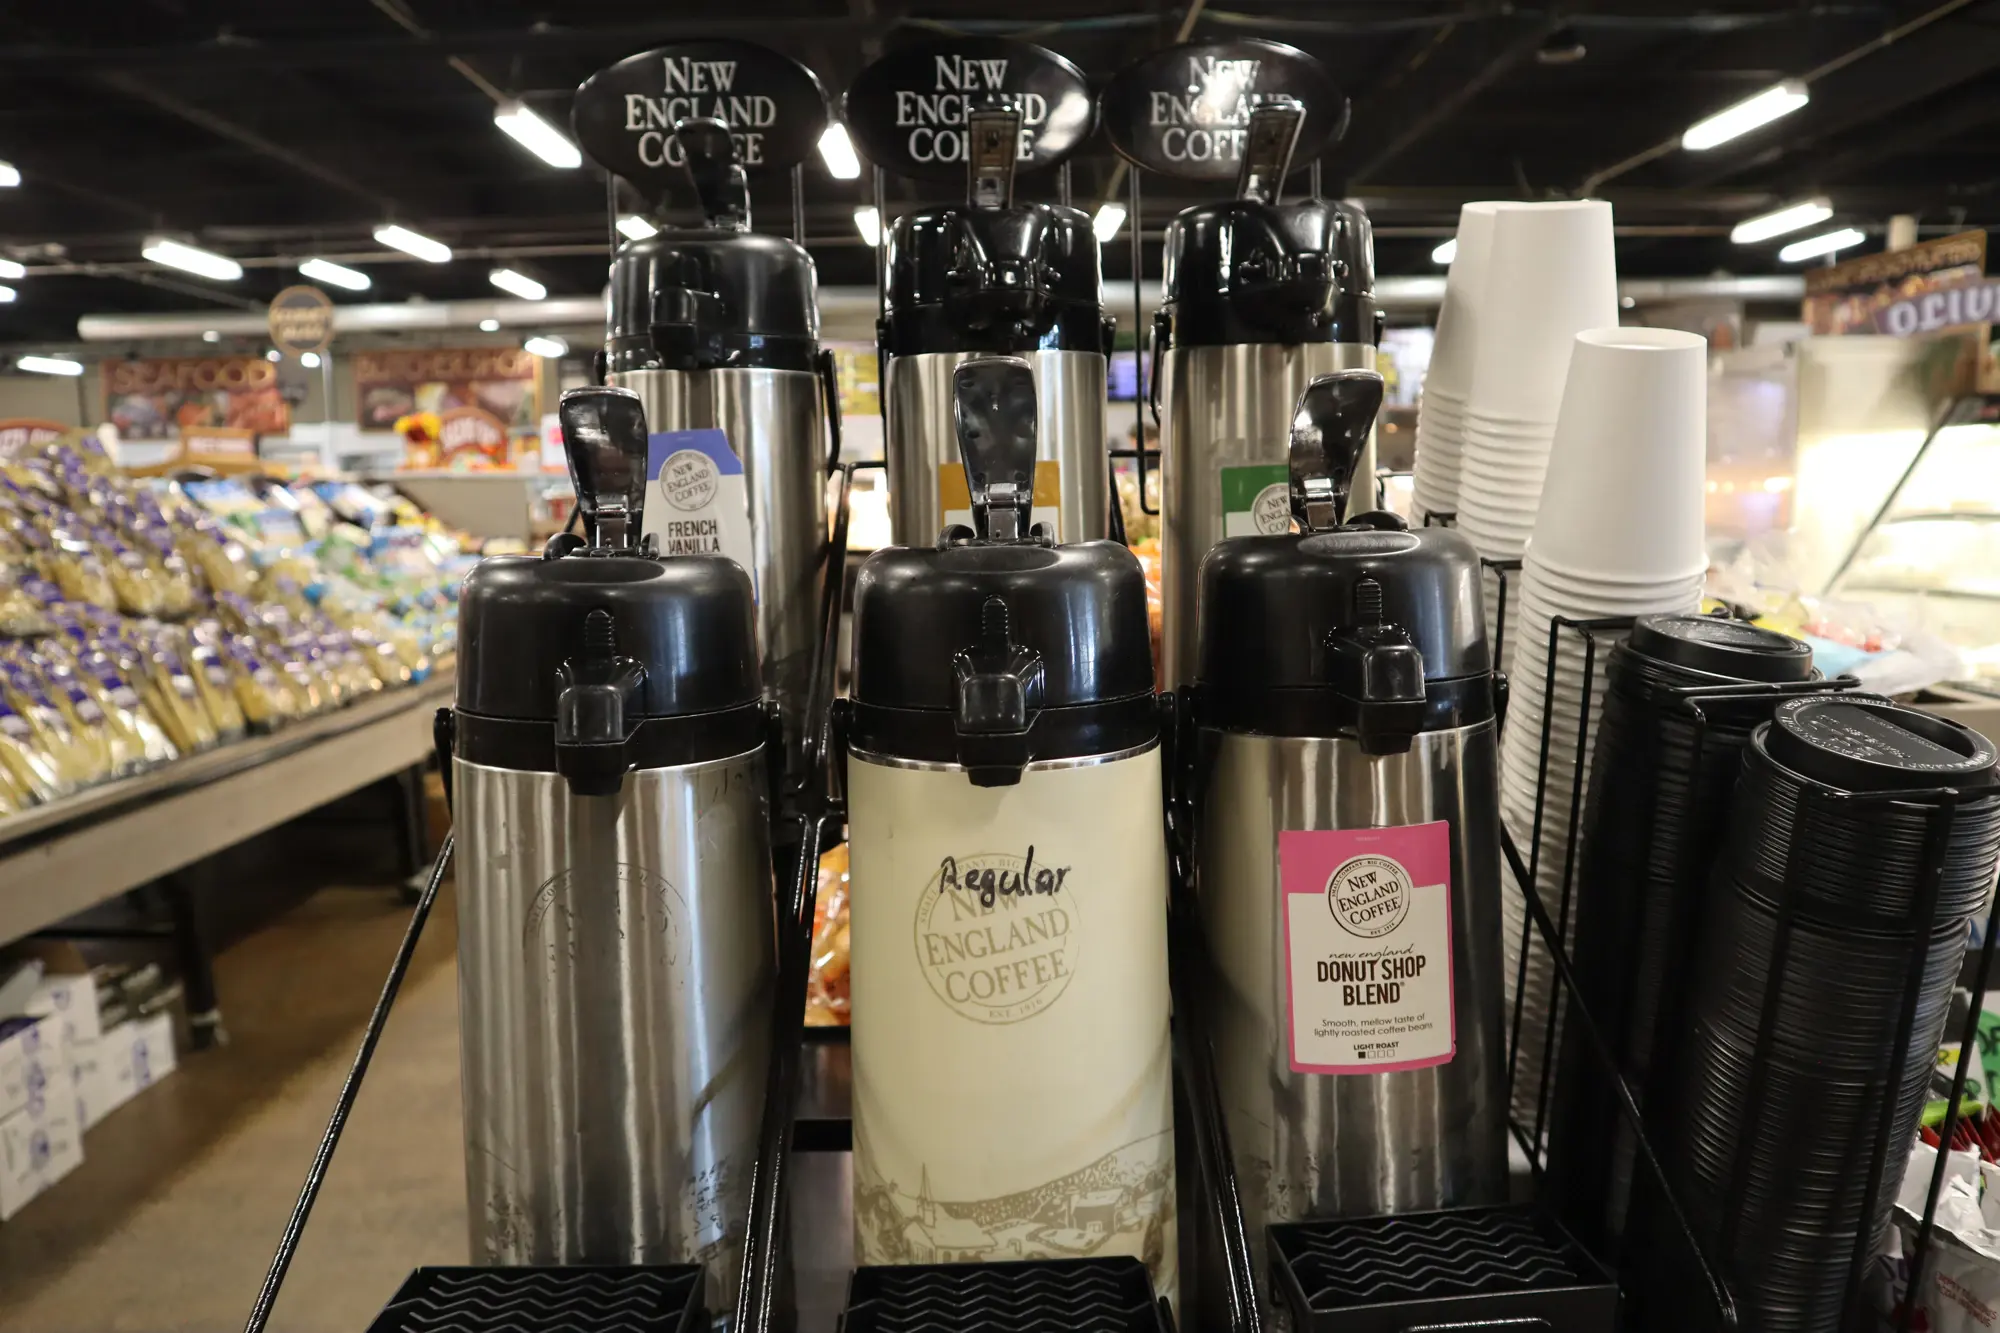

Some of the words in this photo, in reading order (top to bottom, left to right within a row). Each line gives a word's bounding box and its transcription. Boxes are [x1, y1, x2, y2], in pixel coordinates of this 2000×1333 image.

[663, 56, 738, 94] NEW
[934, 54, 1009, 91] NEW
[895, 90, 1047, 126] ENGLD
[1150, 91, 1297, 125] ENGLA
[638, 131, 764, 168] COEE
[1162, 127, 1248, 162] COFF
[1887, 282, 2000, 337] OLIV
[114, 360, 277, 393] SEAFOOD
[668, 519, 718, 538] FRENCH
[1260, 507, 1291, 525] ENGLA
[667, 537, 721, 555] VANILLA
[939, 845, 1072, 909] Regular
[1347, 870, 1377, 893] NEW
[1379, 861, 1399, 875] COFFEE
[1338, 880, 1399, 913] ENGLAND
[1350, 897, 1401, 925] COFFEE
[923, 907, 1070, 967] ENGLAND
[1317, 959, 1378, 982] DONUT
[1381, 955, 1426, 980] SHOP
[1358, 942, 1415, 966] england
[945, 948, 1069, 1004] COFFEE
[1314, 1028, 1340, 1038] lightly
[1341, 1027, 1375, 1037] roasted
[1377, 1026, 1406, 1035] coffee
[1408, 1022, 1433, 1032] beans
[1322, 1018, 1358, 1028] Smooth,
[1361, 1018, 1392, 1027] mellow
[1394, 1015, 1415, 1024] taste
[1416, 1012, 1426, 1021] of
[1353, 1043, 1374, 1051] LIGHT
[1376, 1041, 1400, 1049] ROAST
